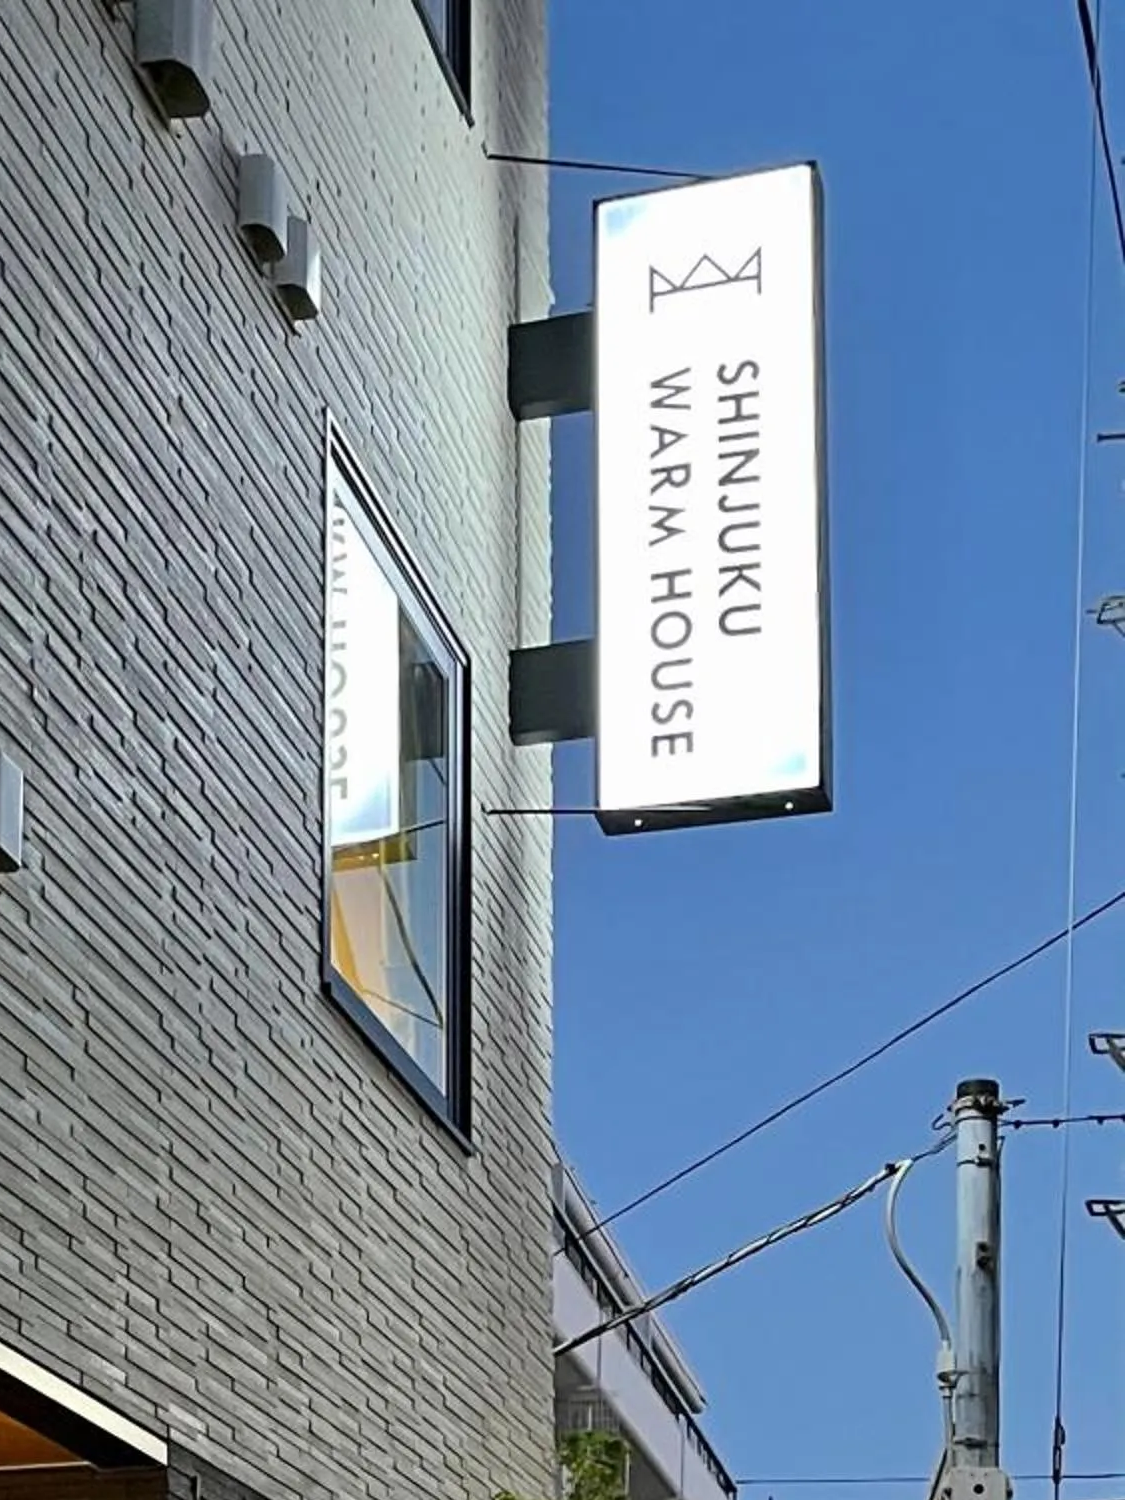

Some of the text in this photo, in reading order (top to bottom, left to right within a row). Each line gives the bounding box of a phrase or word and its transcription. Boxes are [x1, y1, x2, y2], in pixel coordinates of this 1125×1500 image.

[648, 366, 694, 759] WARM HOUSE
[717, 360, 763, 637] SHINJUKU
